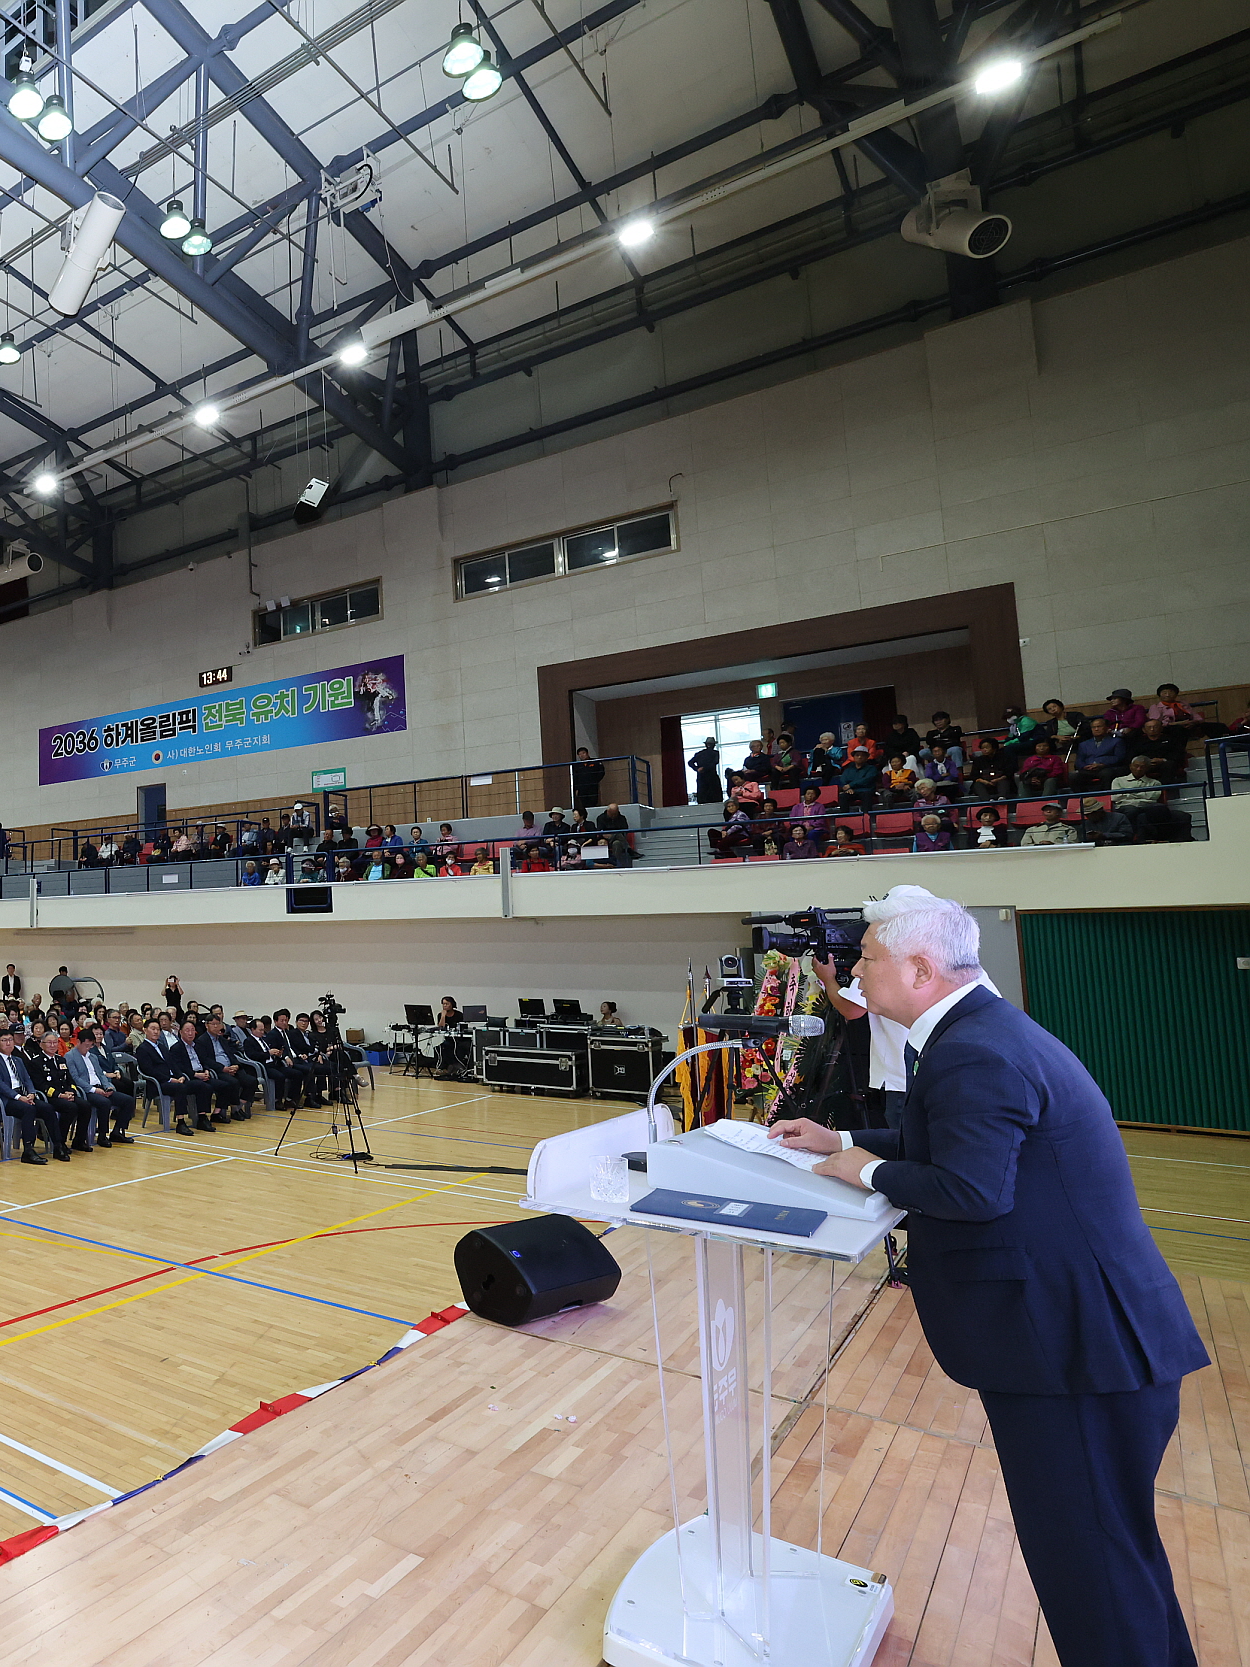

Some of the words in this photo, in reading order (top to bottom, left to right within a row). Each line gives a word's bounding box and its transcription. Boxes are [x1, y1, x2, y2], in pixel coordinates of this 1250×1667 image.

[201, 668, 227, 685] 13:44
[51, 727, 99, 759] 2036
[102, 707, 198, 749] 하계올림픽
[202, 698, 246, 732] 전북
[251, 687, 297, 724] 유치
[303, 676, 354, 714] 기원
[225, 734, 271, 751] 무주군지회
[114, 756, 136, 768] 무주군
